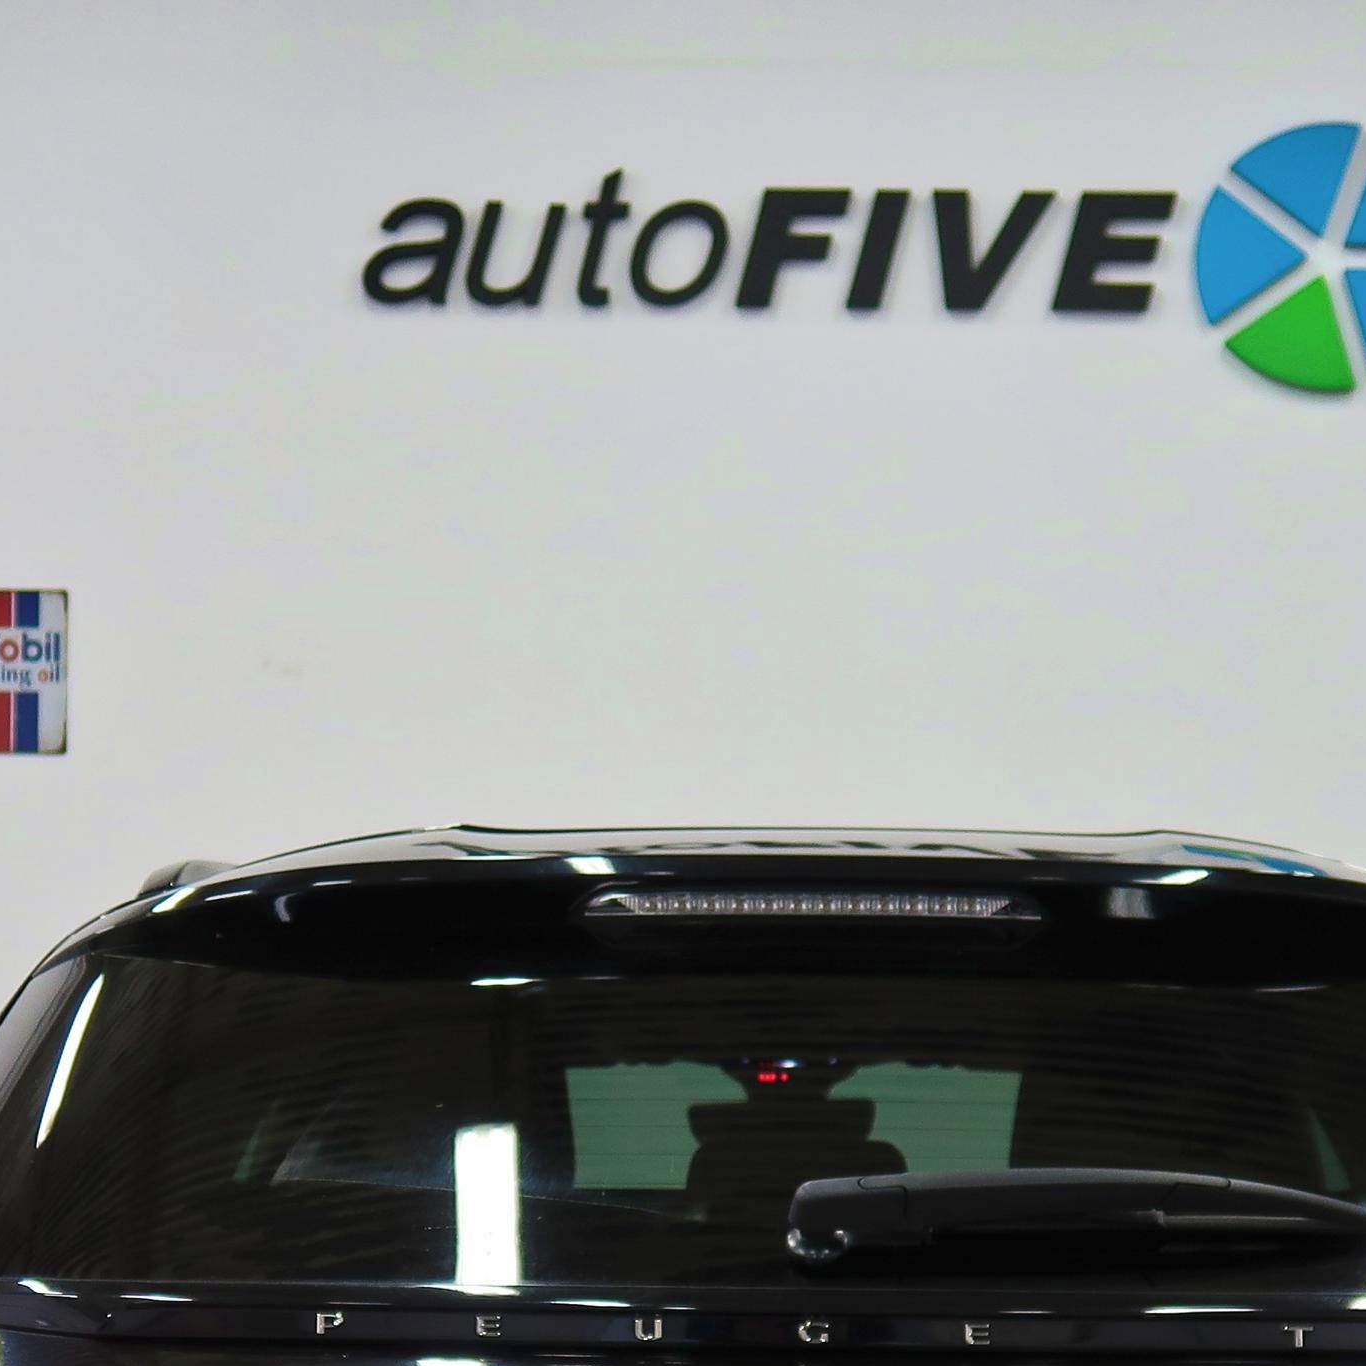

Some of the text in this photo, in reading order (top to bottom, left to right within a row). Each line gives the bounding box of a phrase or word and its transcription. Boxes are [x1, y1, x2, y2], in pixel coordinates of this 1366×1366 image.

[361, 167, 1178, 313] autoFIVE
[37, 664, 60, 684] oil
[315, 1311, 1315, 1348] PEUGET
